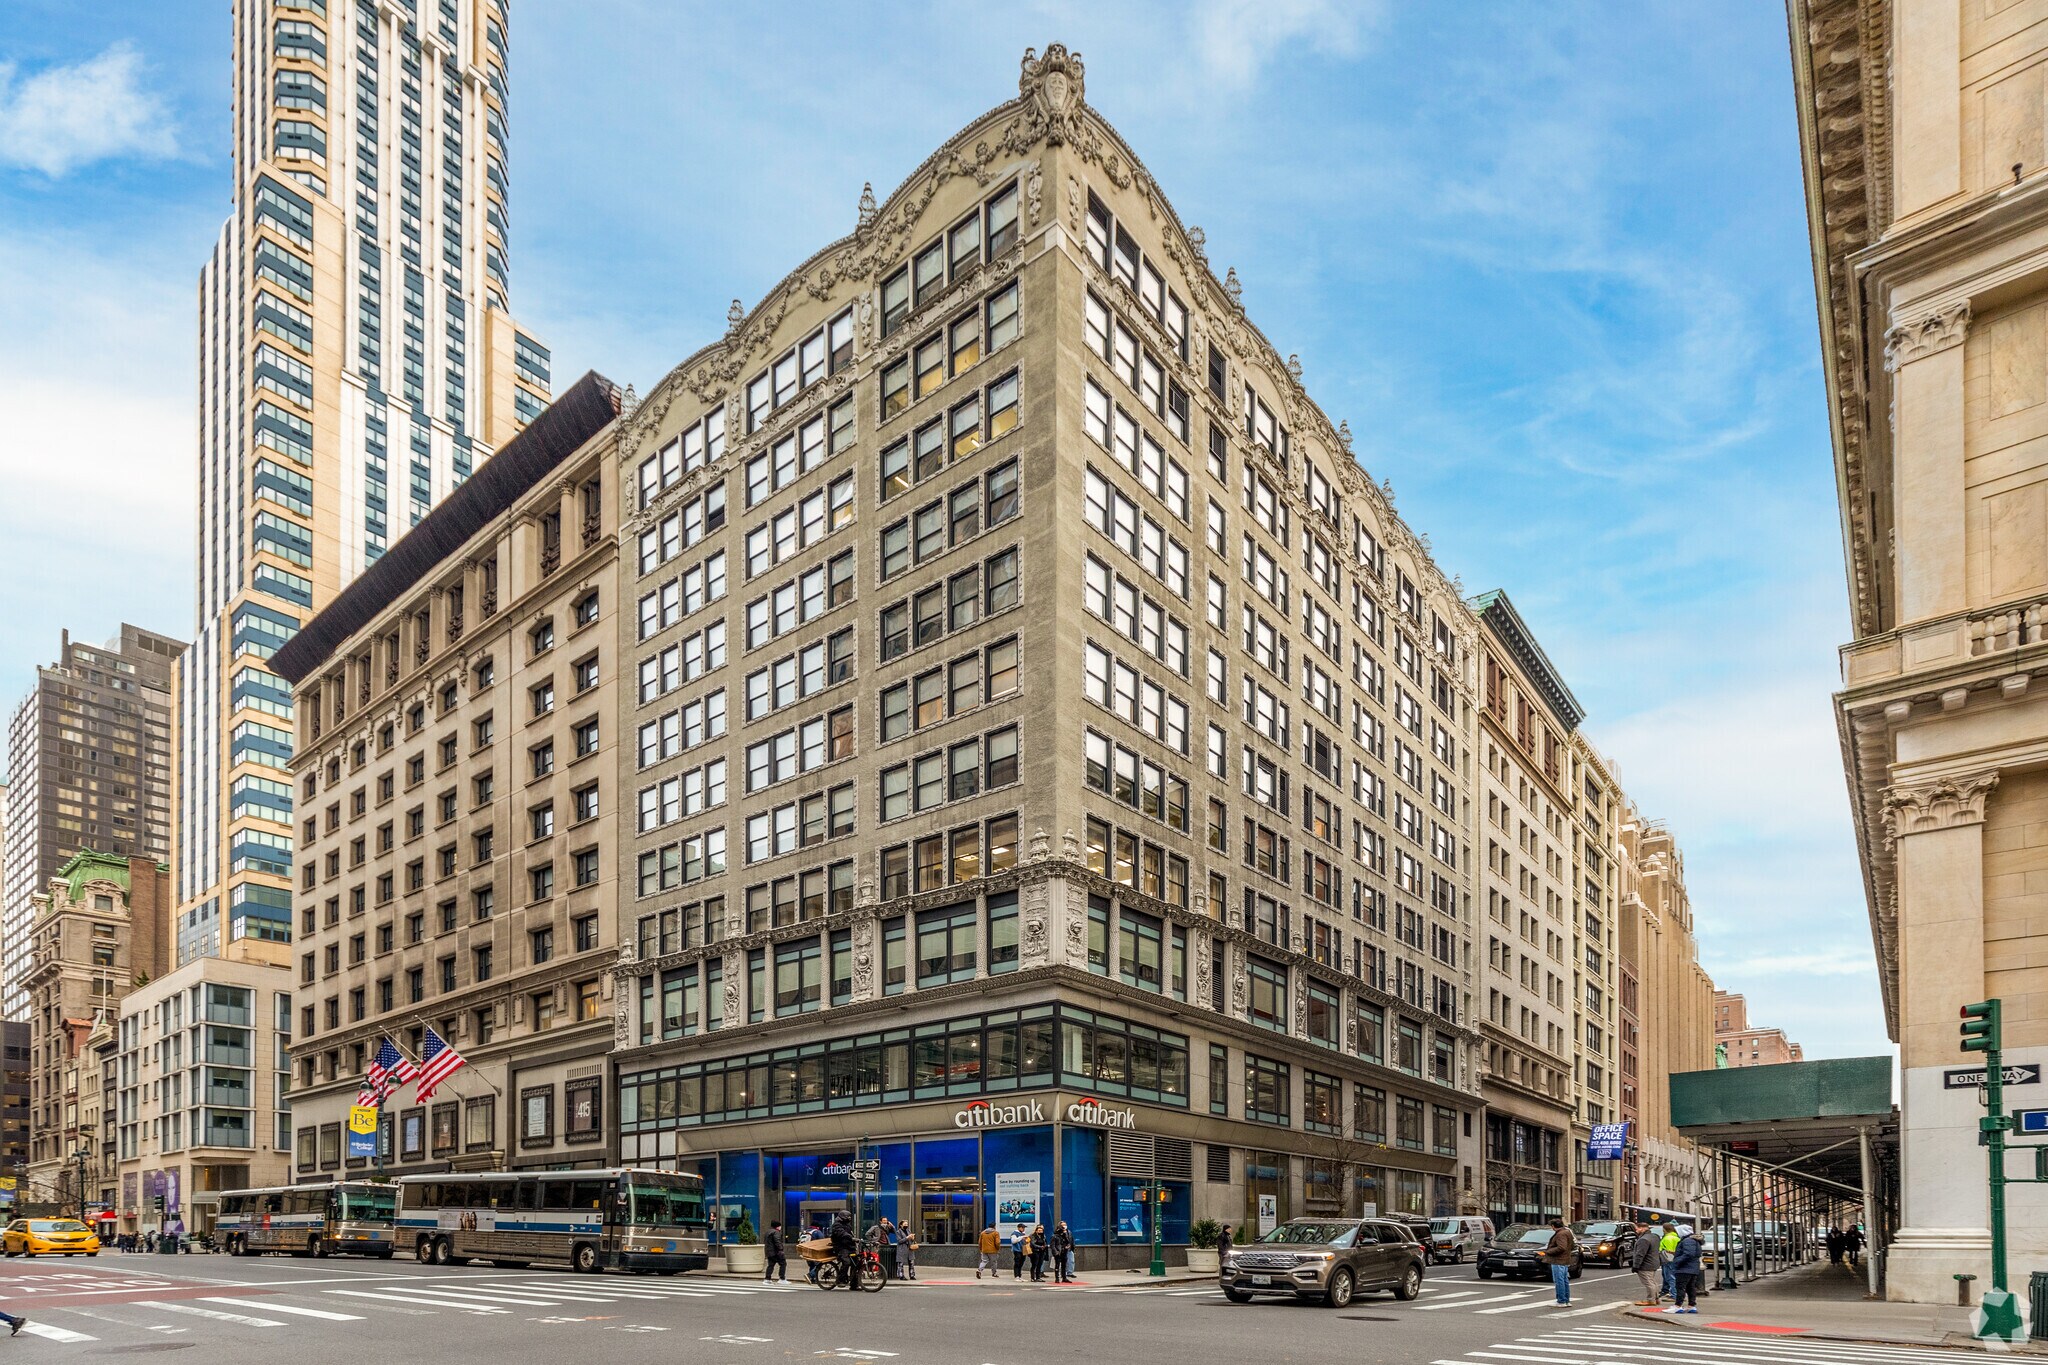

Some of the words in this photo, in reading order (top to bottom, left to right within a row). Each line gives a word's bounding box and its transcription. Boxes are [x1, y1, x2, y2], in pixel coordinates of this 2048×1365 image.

[1957, 1074, 1984, 1083] ONE
[577, 1101, 591, 1118] 415
[955, 1099, 1044, 1128] citibank
[1067, 1099, 1135, 1130] citibank
[354, 1114, 373, 1126] Be
